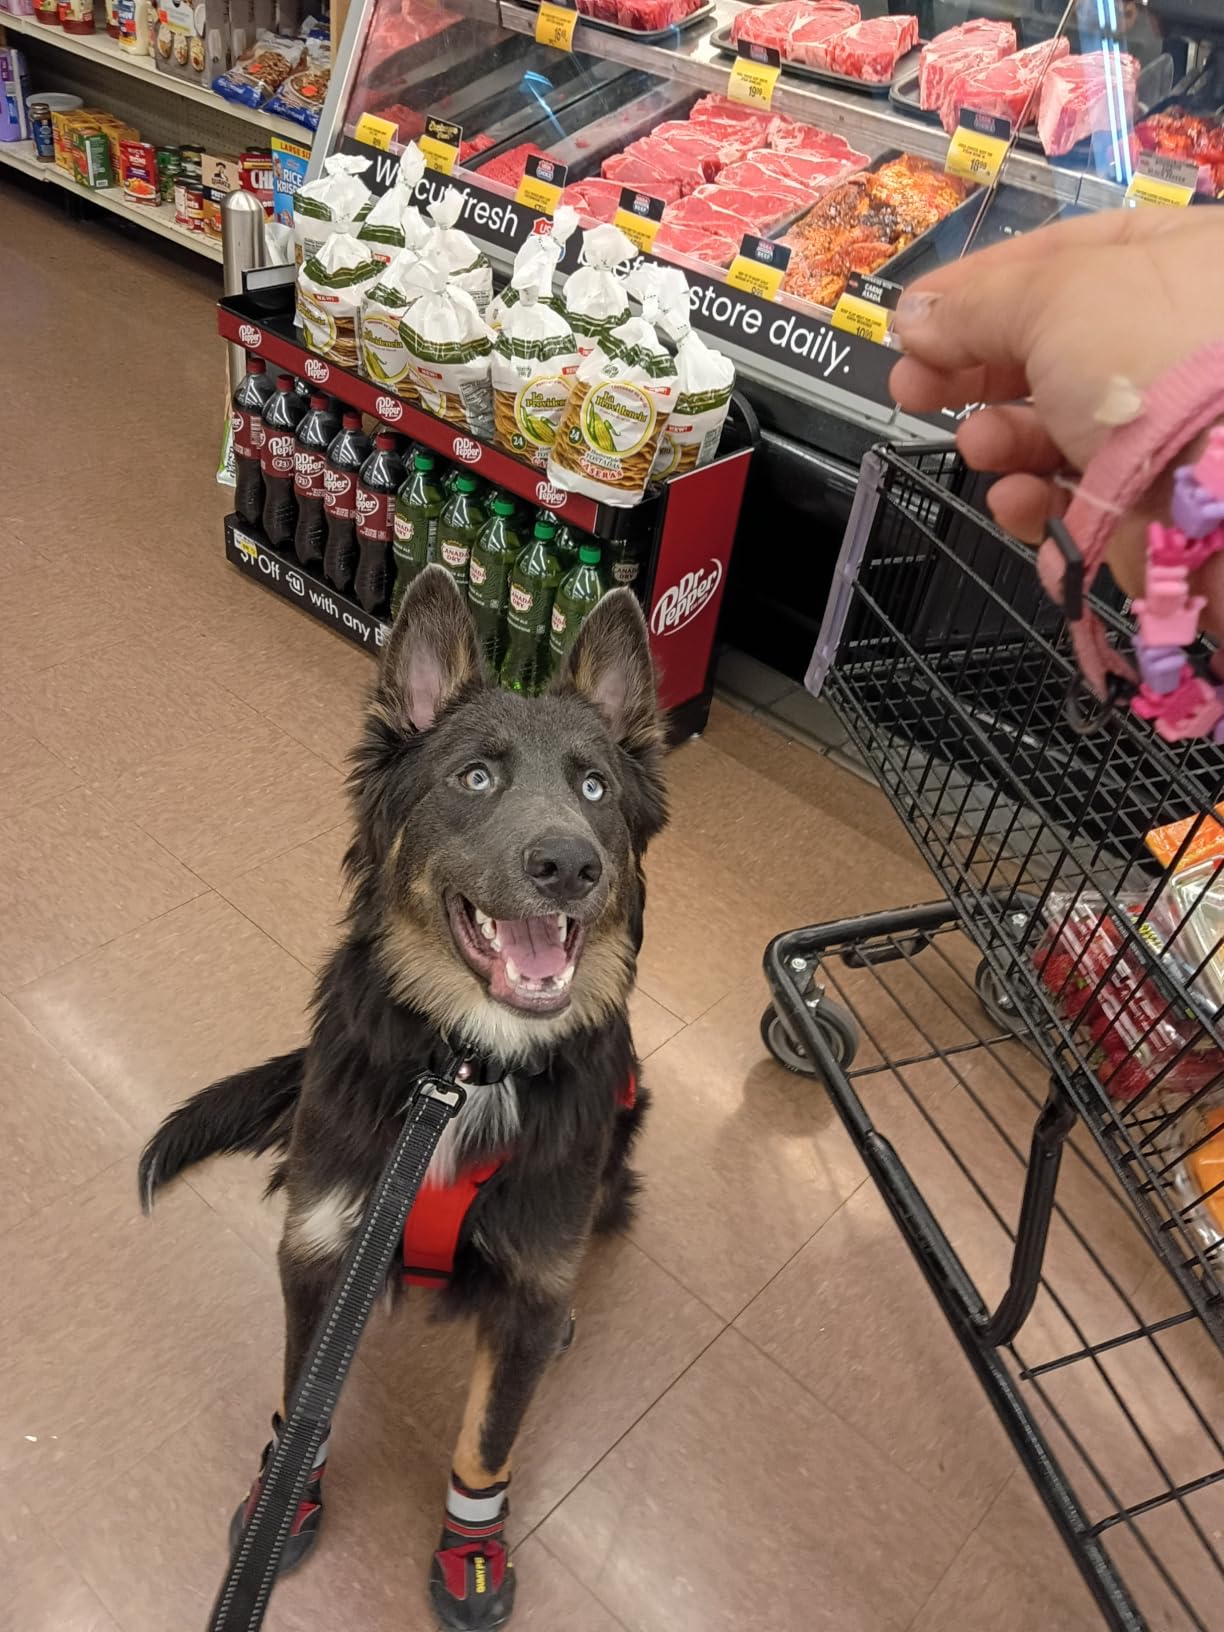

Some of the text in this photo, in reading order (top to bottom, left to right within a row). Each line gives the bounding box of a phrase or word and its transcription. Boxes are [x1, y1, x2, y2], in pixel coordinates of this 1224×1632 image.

[280, 141, 311, 160] LARGE SIZ
[250, 169, 273, 189] CHI
[283, 168, 303, 188] RICE
[375, 155, 400, 187] W
[414, 178, 453, 205] cu
[462, 187, 519, 238] fresh
[688, 285, 762, 335] store
[769, 316, 851, 377] daily.
[306, 359, 330, 381] Pepper
[377, 397, 402, 418] Pepper
[462, 437, 475, 449] Dr
[513, 436, 524, 447] 24
[569, 429, 581, 441] 24
[455, 437, 481, 459] Pepper
[680, 567, 705, 600] Dr
[257, 554, 280, 582] Off
[308, 588, 339, 619] with
[342, 612, 371, 642] any
[374, 626, 385, 647] B
[657, 570, 718, 636] Pepper
